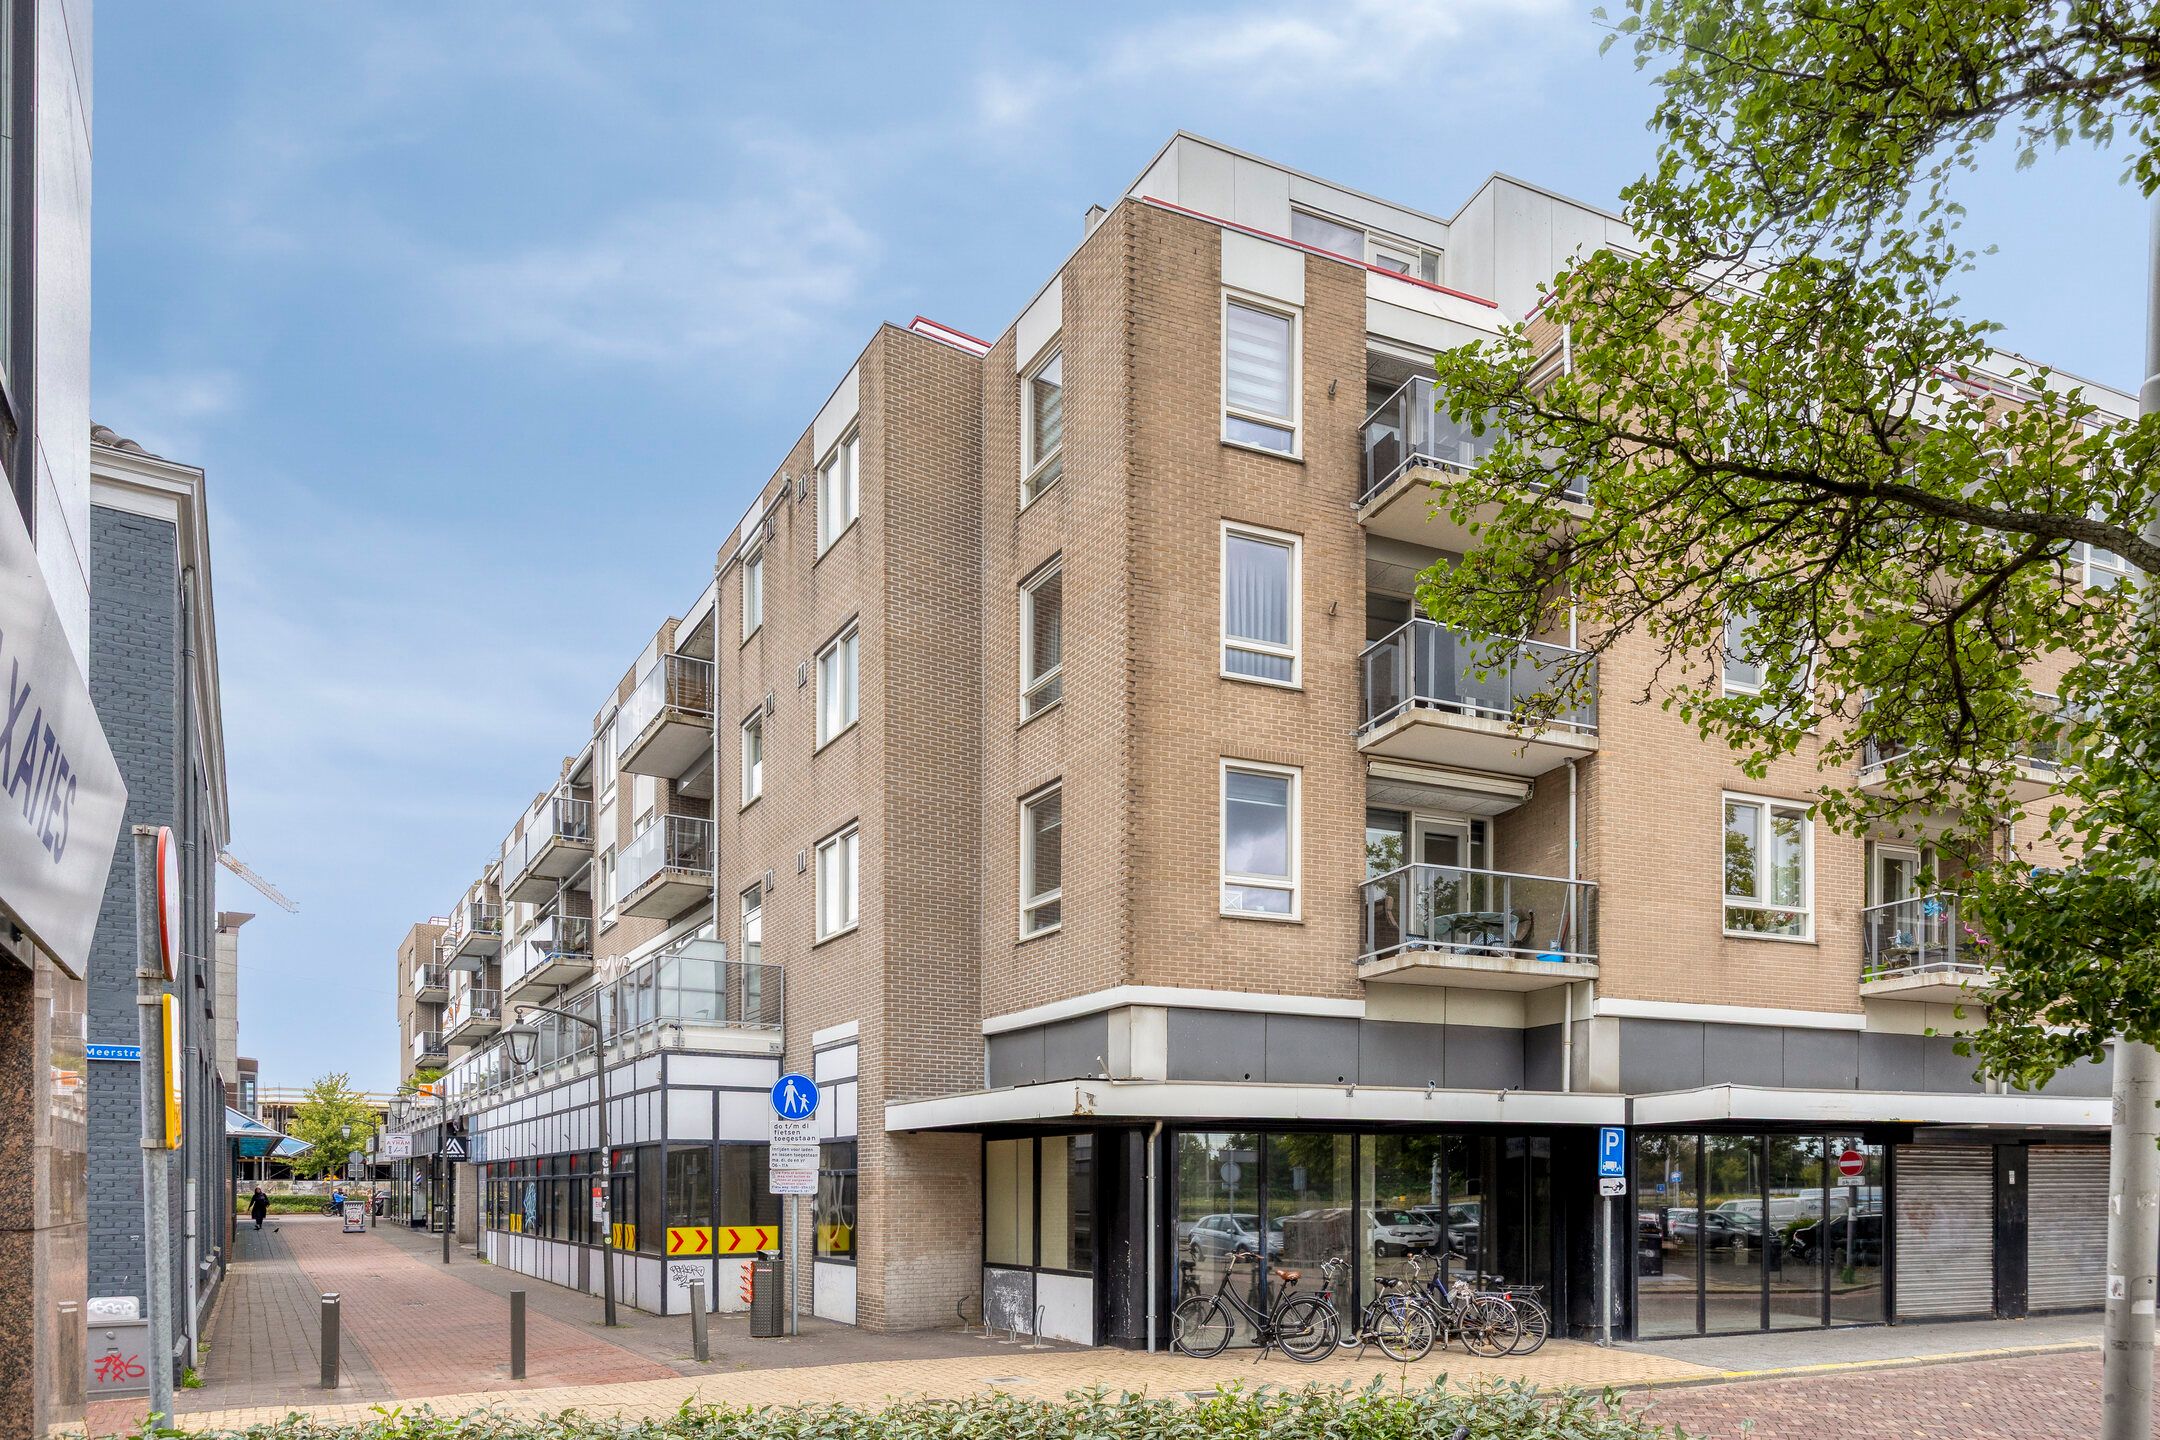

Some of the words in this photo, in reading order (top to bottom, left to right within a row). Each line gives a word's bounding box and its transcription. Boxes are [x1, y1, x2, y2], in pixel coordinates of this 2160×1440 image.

[0, 628, 77, 865] XATIES
[86, 1048, 140, 1057] Meerstra
[1606, 1132, 1619, 1155] P
